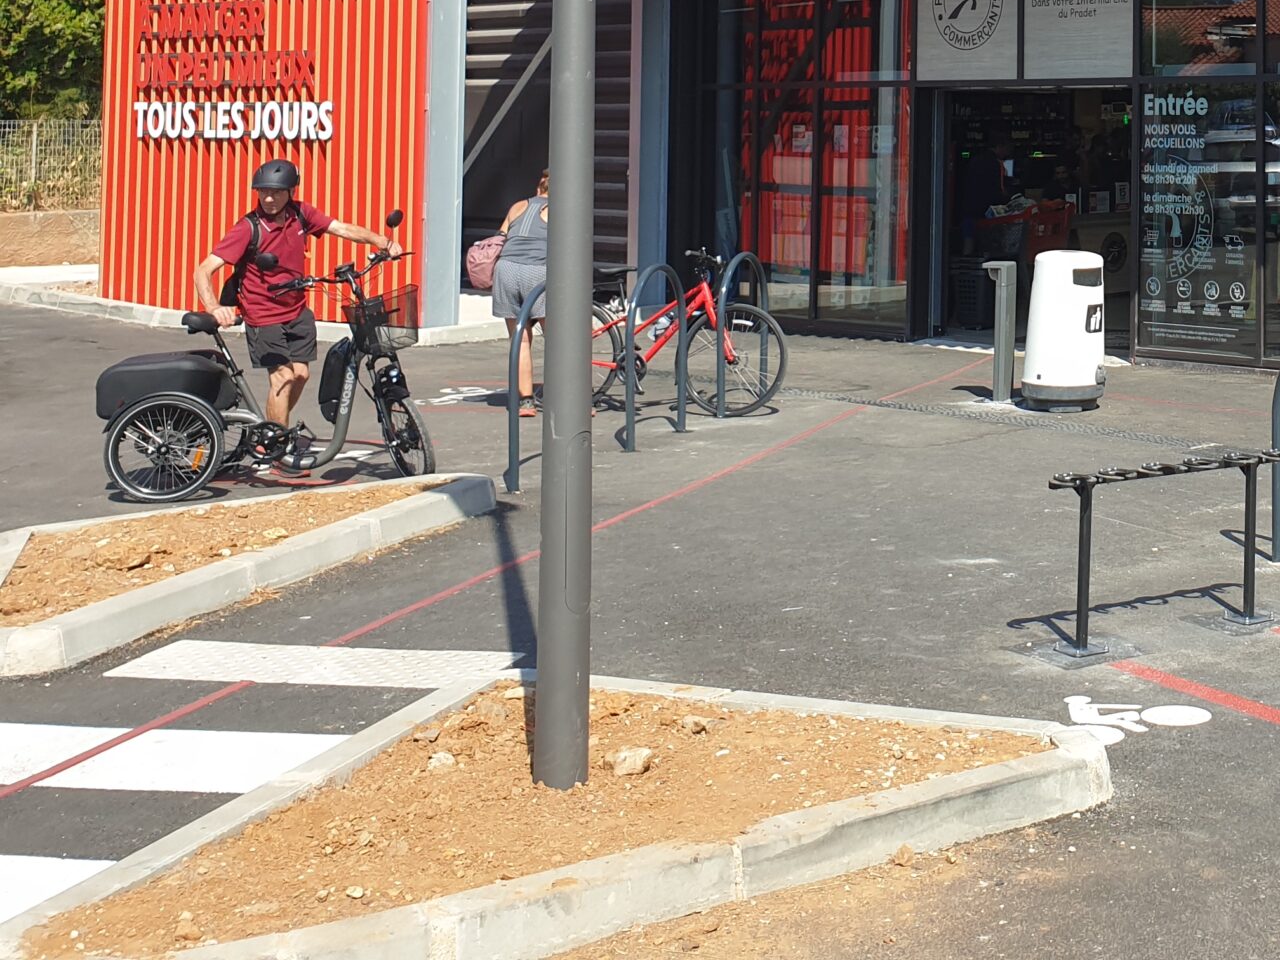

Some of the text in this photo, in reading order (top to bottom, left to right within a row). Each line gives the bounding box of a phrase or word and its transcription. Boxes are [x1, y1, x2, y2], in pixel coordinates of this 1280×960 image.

[1058, 8, 1097, 18] du Pradet
[162, 1, 266, 39] MANGER
[136, 50, 317, 89] UN PEU MIEUX
[1144, 90, 1208, 115] Entrée
[133, 101, 334, 142] TOUS LES JOURS
[1144, 124, 1196, 135] NOUS VOUS
[1144, 137, 1205, 149] ACCUEILLONS
[1144, 163, 1155, 172] du
[1188, 163, 1218, 173] samedi
[1144, 174, 1154, 184] de
[1155, 174, 1175, 184] 8h30
[1143, 192, 1192, 203] le dimanche
[1143, 204, 1154, 213] de
[1155, 204, 1175, 214] 8h30
[1182, 205, 1205, 215] 12h30
